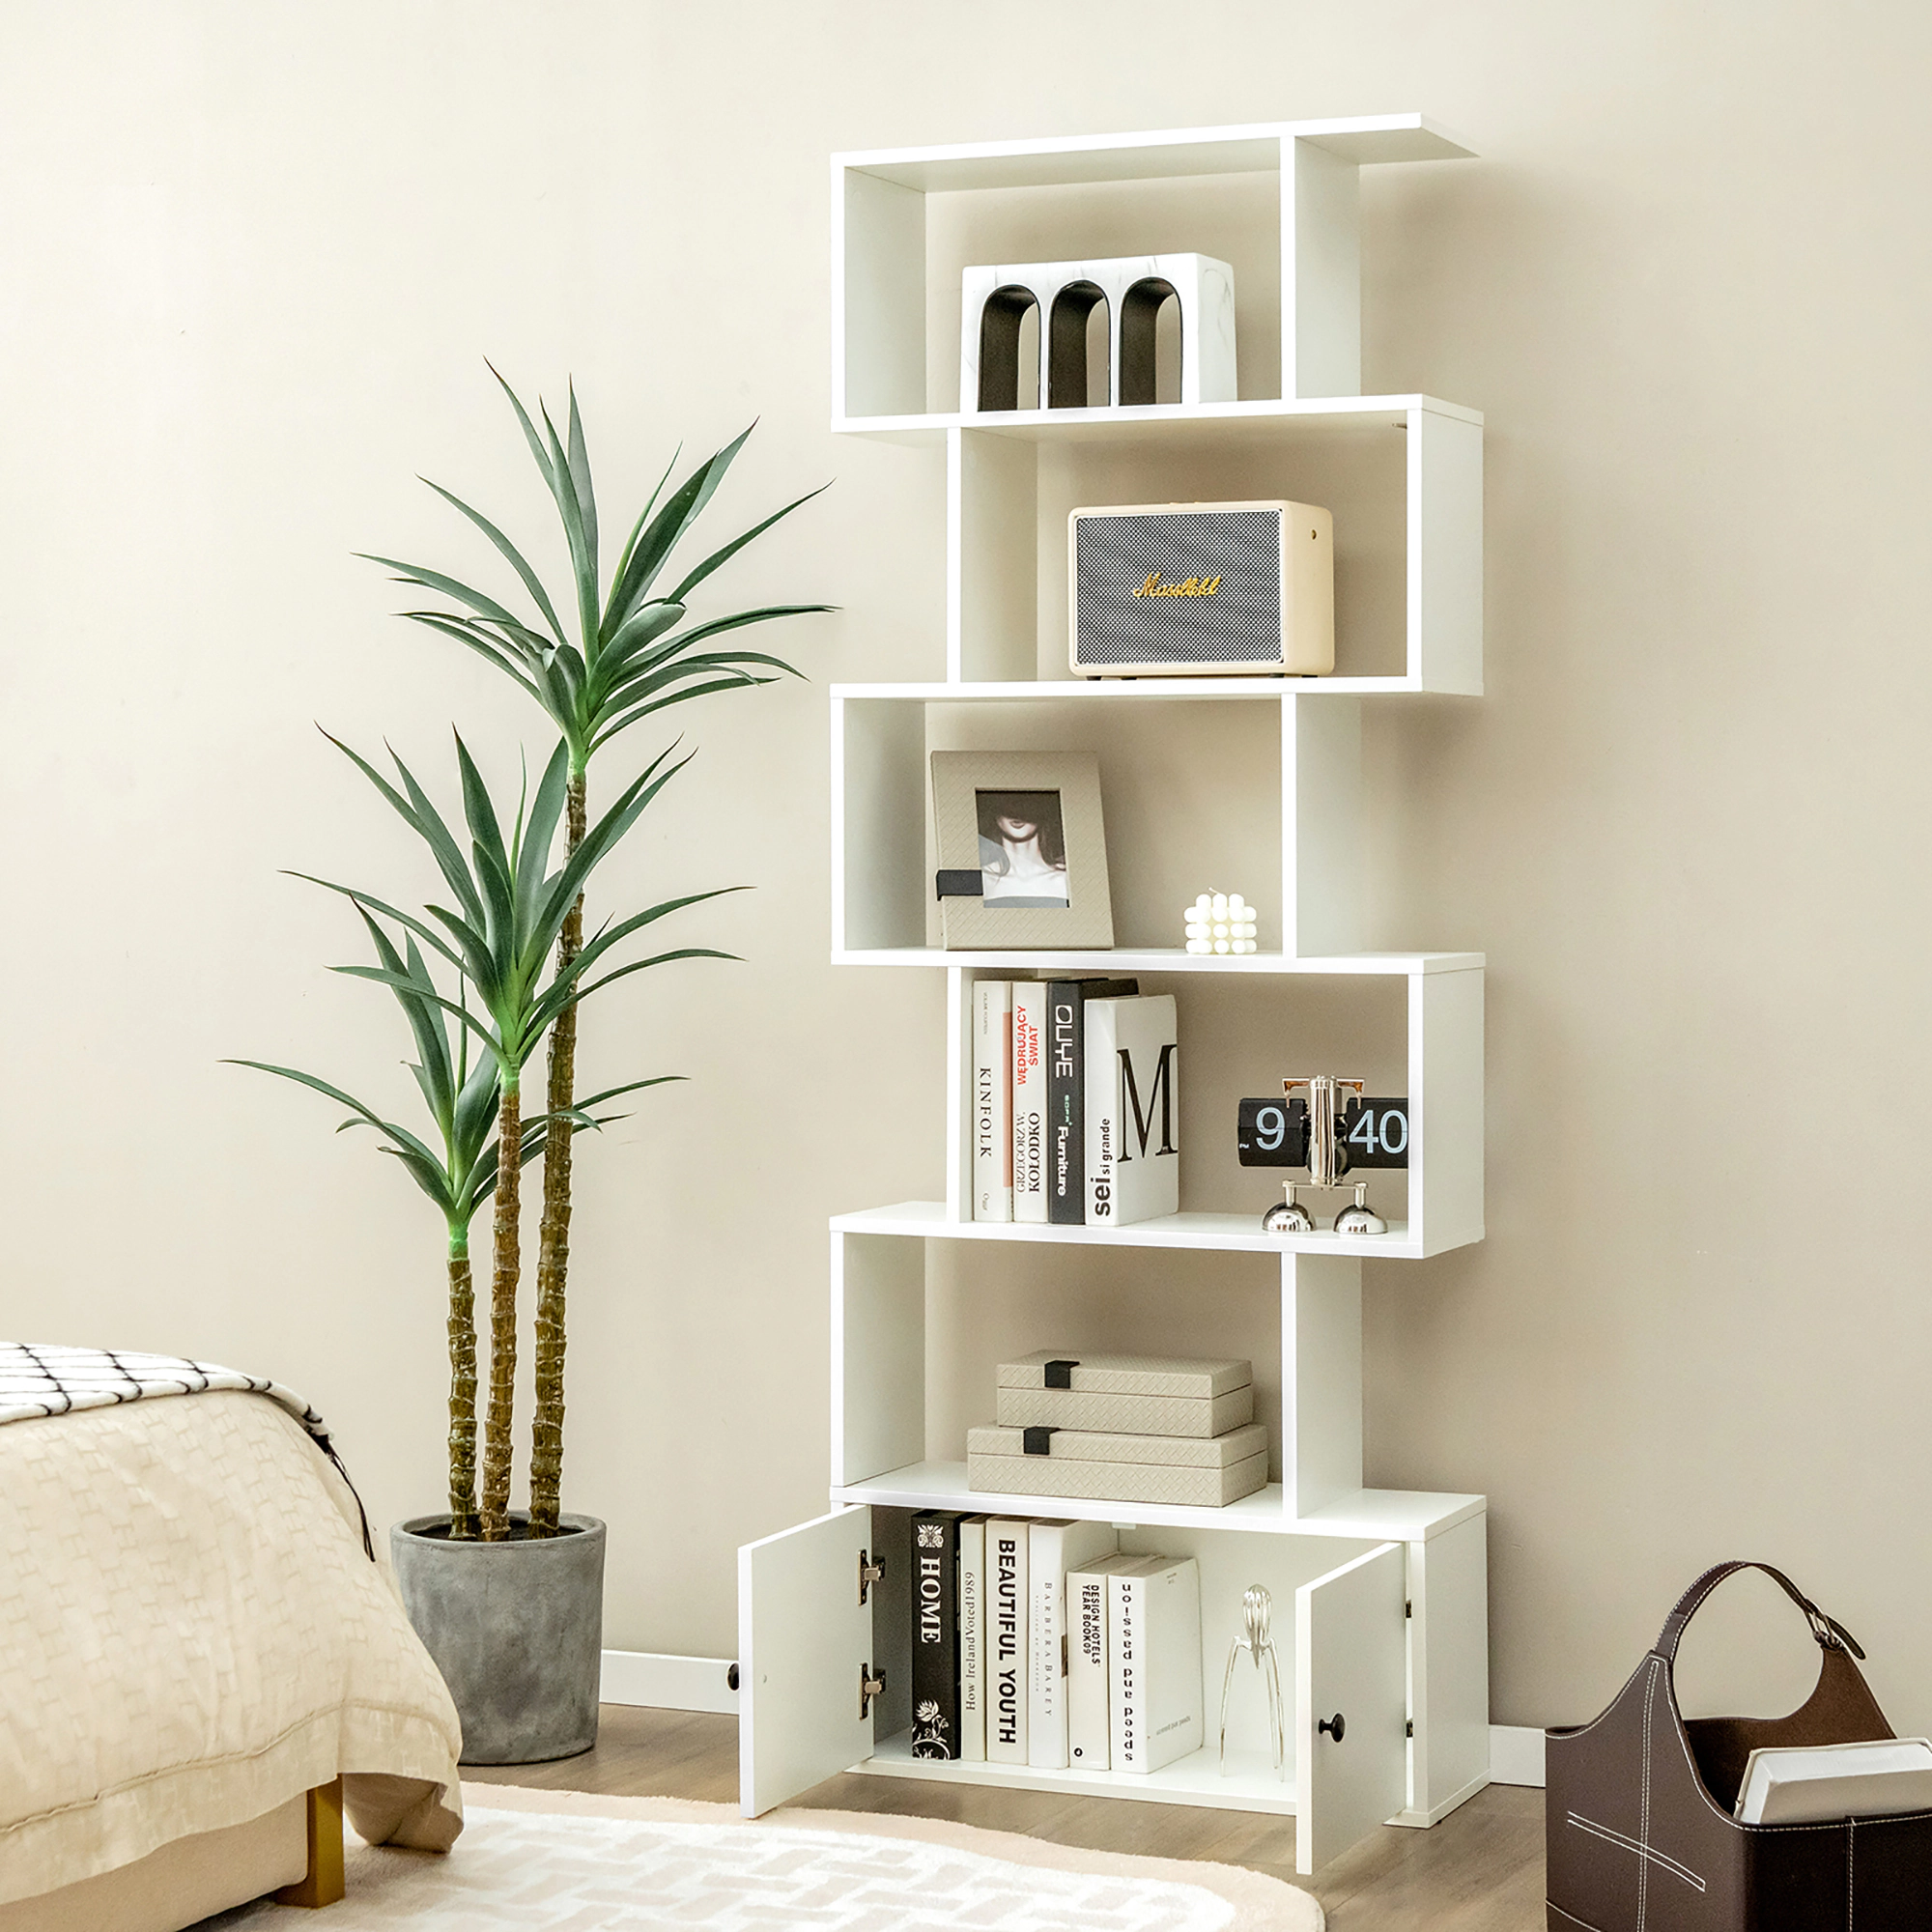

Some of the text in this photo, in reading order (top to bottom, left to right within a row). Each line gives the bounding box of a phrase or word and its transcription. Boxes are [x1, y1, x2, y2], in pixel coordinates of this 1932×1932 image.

[1017, 1005, 1029, 1085] WĘDRUJĄCY
[1028, 1025, 1038, 1066] ŚWIAT
[980, 1067, 992, 1157] KINFOLK
[1117, 1043, 1178, 1163] M
[1256, 1106, 1408, 1154] 9 40
[1028, 1112, 1040, 1192] KOŁODKO
[1058, 1126, 1069, 1196] Furniture
[1099, 1119, 1113, 1161] grande
[1091, 1178, 1111, 1217] sei
[920, 1556, 941, 1644] HOME
[1082, 1584, 1091, 1610] YEAR
[1091, 1584, 1100, 1622] DESIGN
[998, 1539, 1016, 1745] BEAUTIFUL YOUTH
[1043, 1581, 1053, 1717] BARBERA BAREY
[965, 1683, 976, 1711] How
[1123, 1668, 1133, 1699] and
